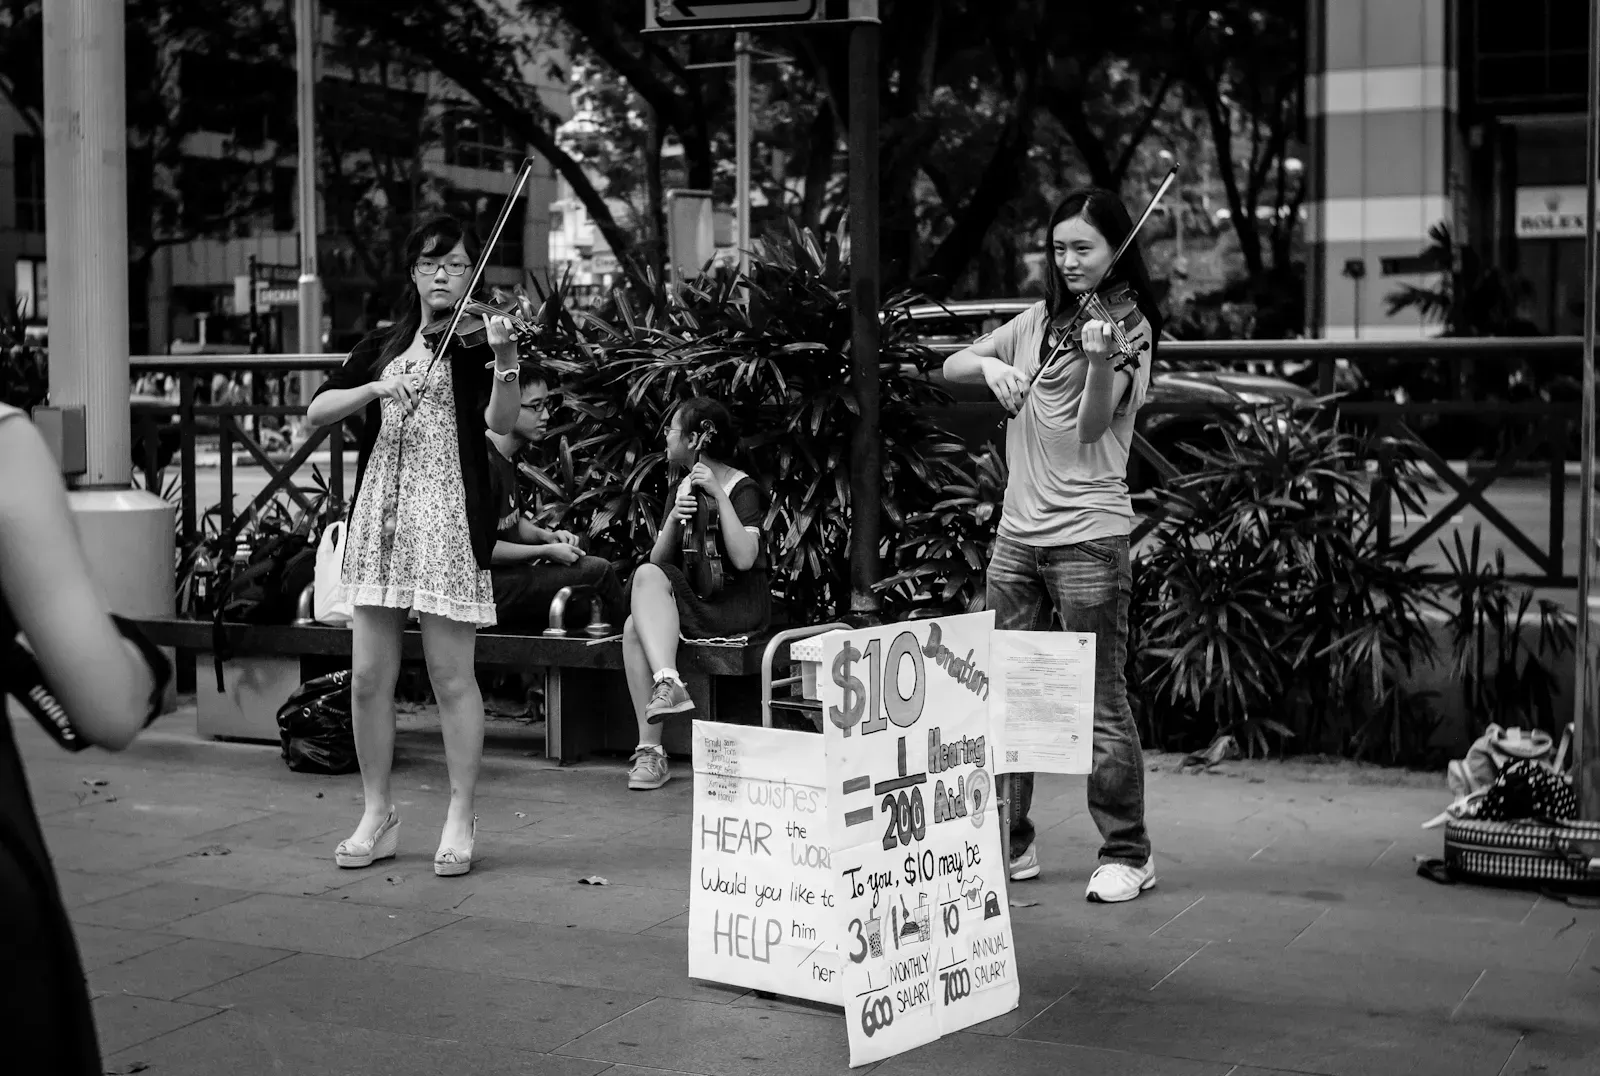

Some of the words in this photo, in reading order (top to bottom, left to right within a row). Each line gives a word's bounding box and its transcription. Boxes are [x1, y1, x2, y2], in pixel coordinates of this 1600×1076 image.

[829, 631, 926, 738] $10
[928, 727, 985, 774] Hearing
[747, 778, 820, 813] wishes
[881, 786, 926, 851] 200
[934, 775, 968, 823] Aid
[701, 814, 772, 856] HEAR
[785, 821, 807, 839] the
[701, 867, 747, 896] Would
[755, 884, 782, 907] you
[790, 881, 816, 905] like
[842, 865, 865, 899] To
[867, 870, 900, 908] you,
[904, 849, 935, 886] $10
[938, 852, 964, 883] may
[965, 841, 982, 868] be
[714, 908, 783, 964] HELP
[791, 919, 816, 940] him
[847, 917, 868, 963] 3
[972, 932, 1009, 960] ANNUAL
[812, 961, 836, 983] her
[889, 952, 930, 985] MONTHLY
[974, 959, 1007, 988] SALARY
[861, 995, 894, 1037] 600
[896, 979, 930, 1013] SALARY
